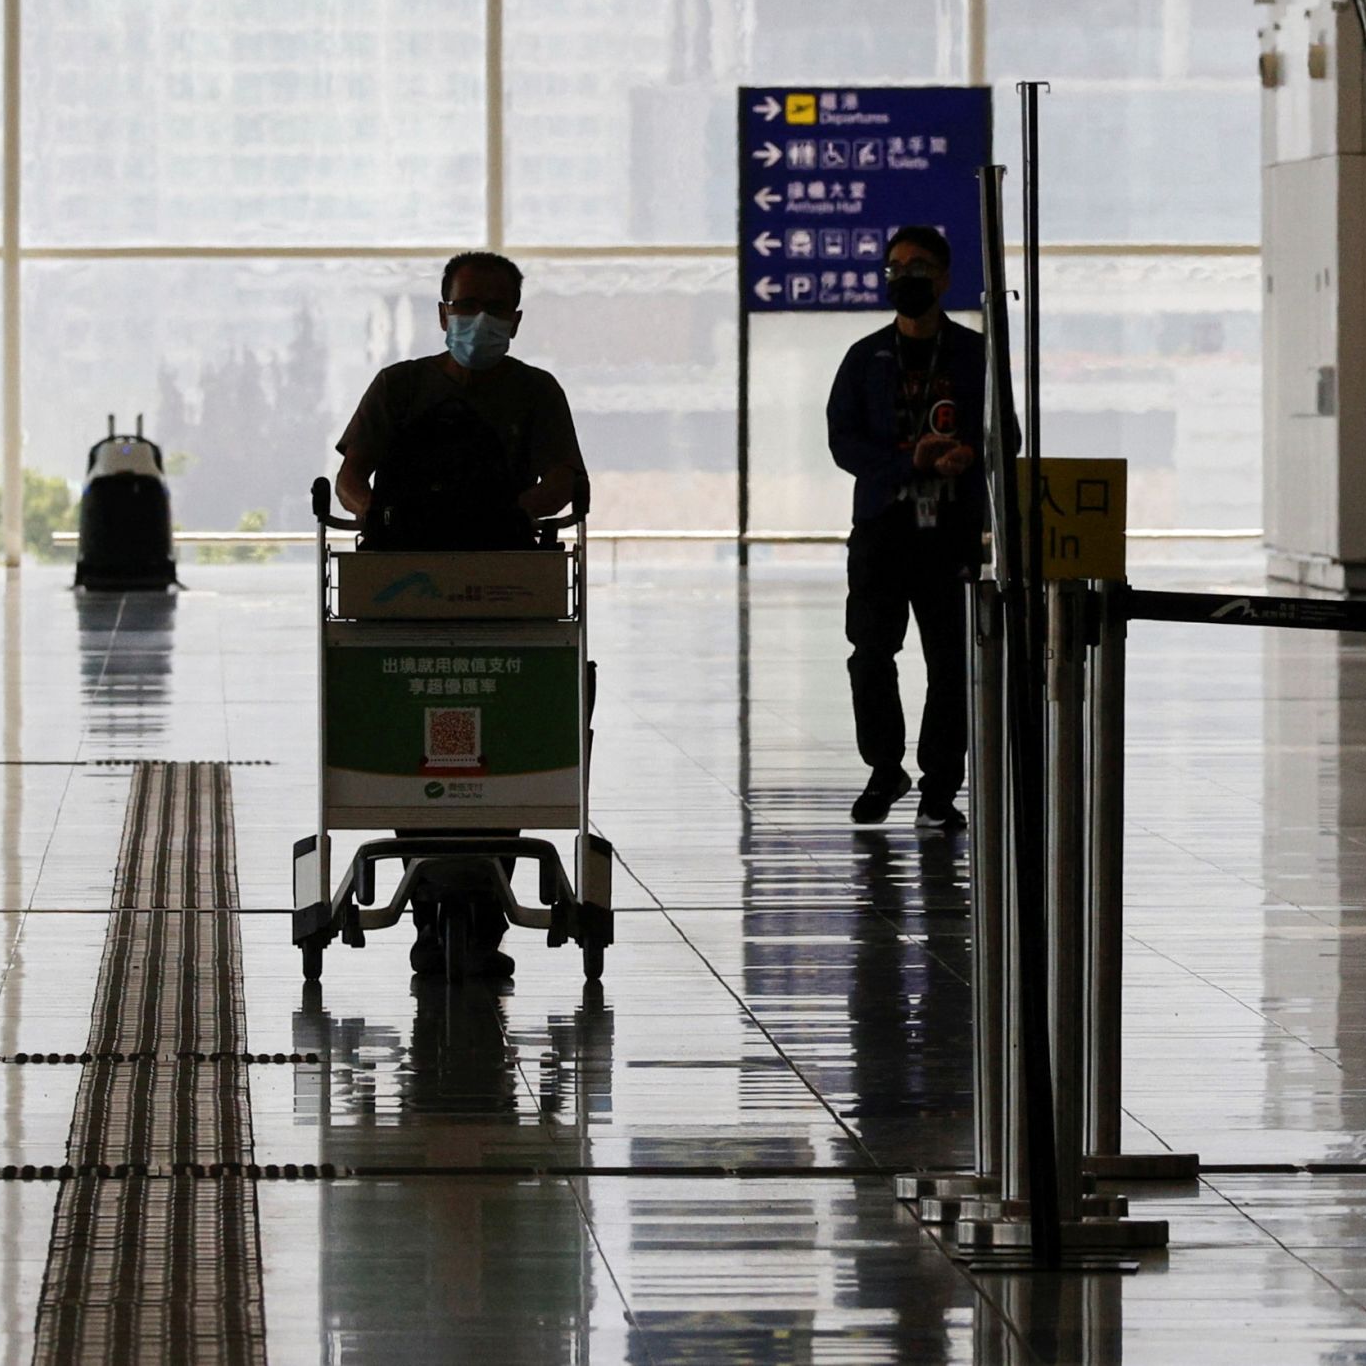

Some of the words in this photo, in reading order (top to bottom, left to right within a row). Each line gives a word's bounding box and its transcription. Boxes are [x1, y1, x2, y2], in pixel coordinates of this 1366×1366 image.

[819, 111, 889, 125] Departures
[792, 279, 811, 301] P
[1050, 526, 1080, 559] In
[382, 656, 522, 674] 出境就用微信支付
